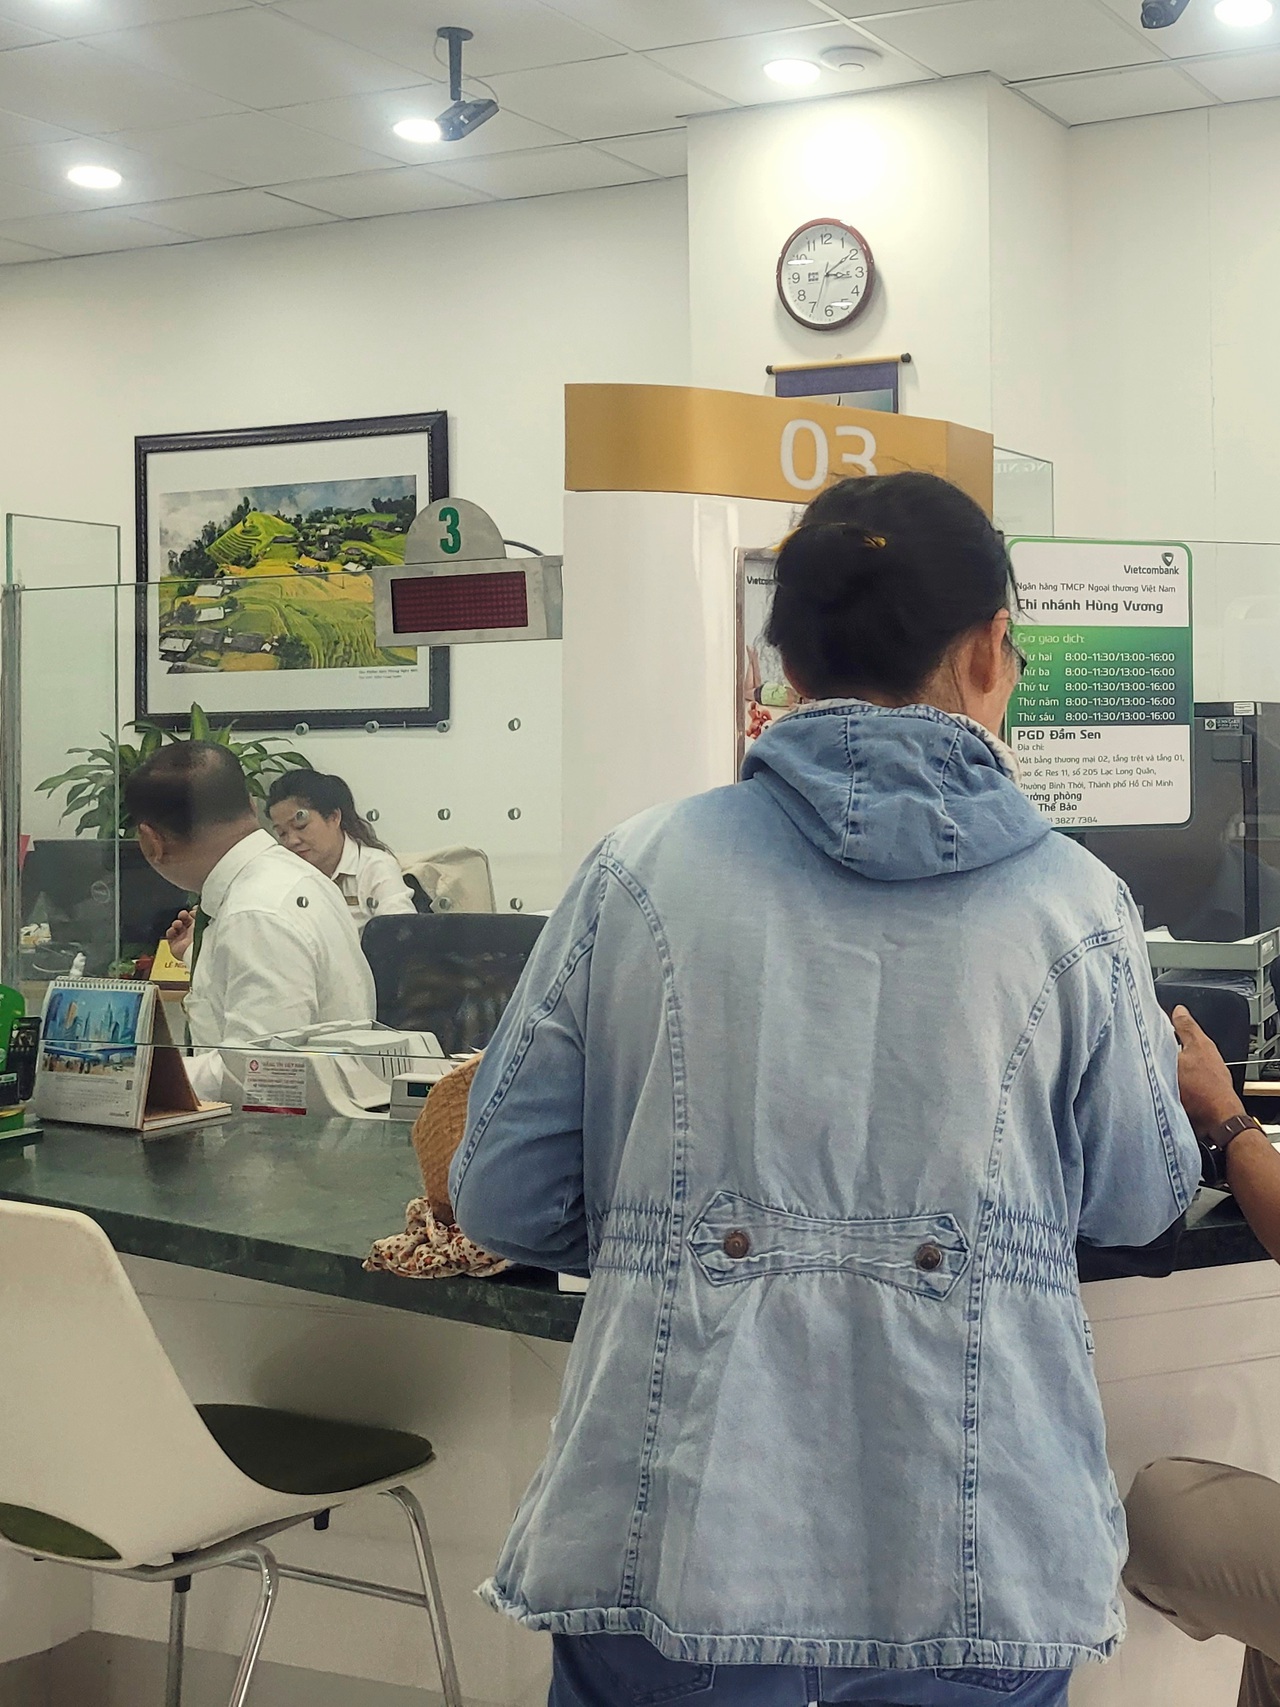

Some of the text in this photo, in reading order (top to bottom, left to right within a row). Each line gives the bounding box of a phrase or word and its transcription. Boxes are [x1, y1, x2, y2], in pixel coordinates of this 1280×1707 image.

[820, 232, 833, 245] 12
[807, 239, 816, 252] 11
[849, 248, 859, 261] 2
[792, 272, 800, 284] 9
[855, 266, 865, 279] 3
[797, 289, 807, 302] 8
[851, 284, 860, 297] 4
[808, 301, 817, 314] 7
[824, 305, 834, 317] 6
[780, 419, 878, 490] 03
[437, 506, 461, 556] 3
[1123, 564, 1180, 575] Vietcombank
[1060, 582, 1085, 591] TMCP
[1088, 583, 1110, 593] Ngoại
[1112, 584, 1139, 593] thương
[1141, 584, 1156, 593] Việt
[1158, 585, 1176, 593] Nam
[1018, 598, 1164, 614] Chi nhánh Hùng Vương
[1038, 634, 1060, 645] giao
[1038, 652, 1053, 661] hai
[1023, 667, 1036, 676] hứ
[1038, 667, 1050, 676] ba
[1017, 682, 1036, 691] Thứ
[1038, 683, 1050, 691] tư
[1017, 697, 1036, 706] Thứ
[1017, 712, 1036, 722] Thứ
[1038, 712, 1055, 722] sáu
[1017, 730, 1045, 740] PGD
[1079, 729, 1101, 740] Sen
[1017, 743, 1030, 751] Địa
[1054, 756, 1080, 764] thương
[1097, 755, 1111, 763] 02,
[1045, 769, 1059, 777] Res
[1061, 769, 1070, 777] 11,
[1072, 767, 1081, 776] số
[1082, 768, 1099, 776] 205
[1100, 768, 1113, 776] Lạc
[1115, 767, 1134, 776] Long
[1112, 779, 1127, 789] phố
[1155, 779, 1174, 787] Minh
[1053, 791, 1082, 802] phòng
[1037, 801, 1078, 812] Thế Bảo
[1055, 817, 1076, 825] 3827
